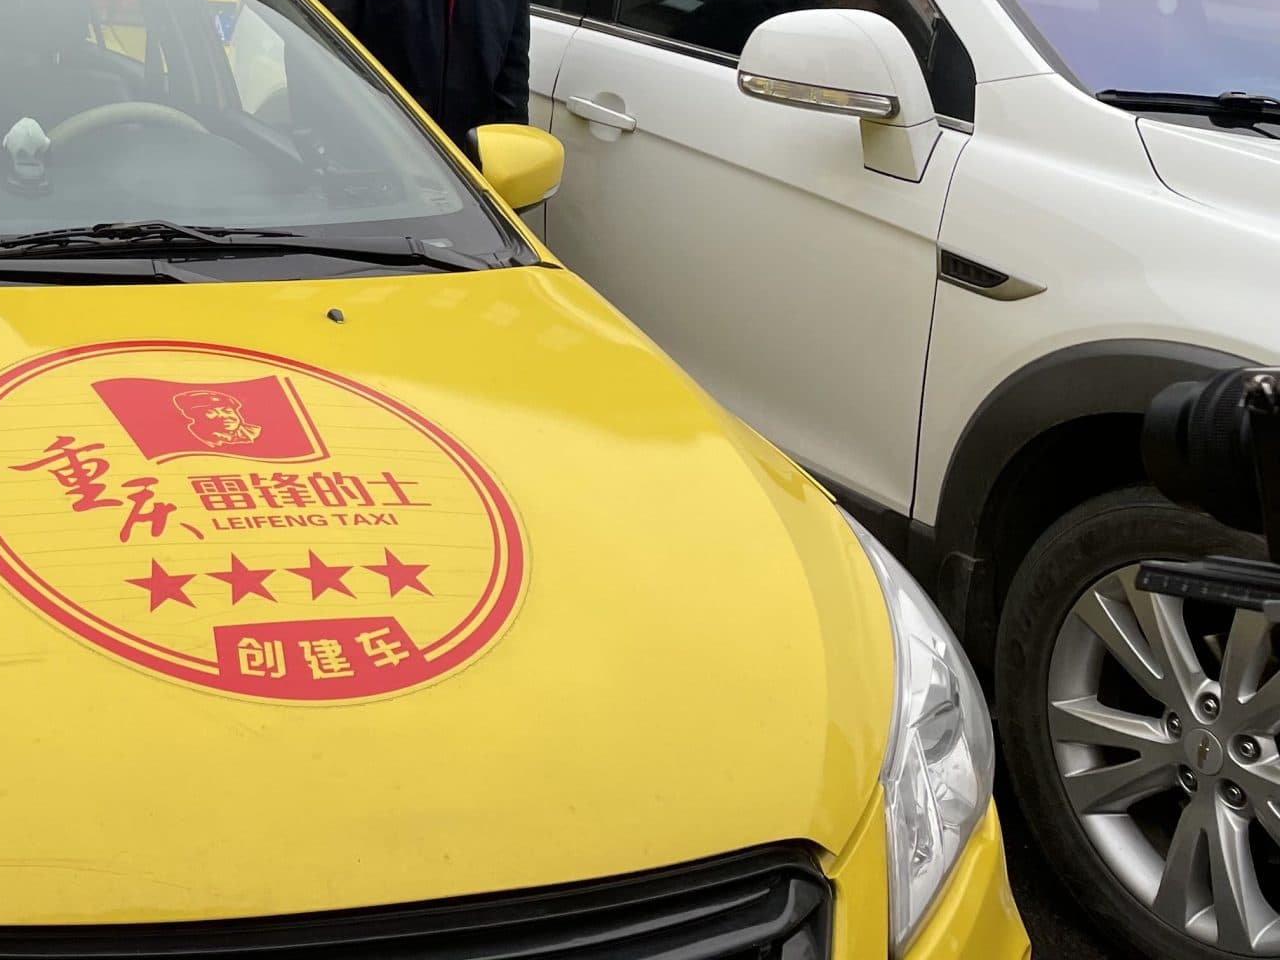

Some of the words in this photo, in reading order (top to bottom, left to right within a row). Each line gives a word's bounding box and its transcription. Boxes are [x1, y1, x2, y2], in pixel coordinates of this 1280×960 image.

[7, 435, 205, 544] 重庆
[187, 471, 433, 511] 雷锋的士
[211, 514, 328, 530] LEIFENG
[331, 512, 399, 526] TAXI
[237, 627, 410, 680] 创建车
